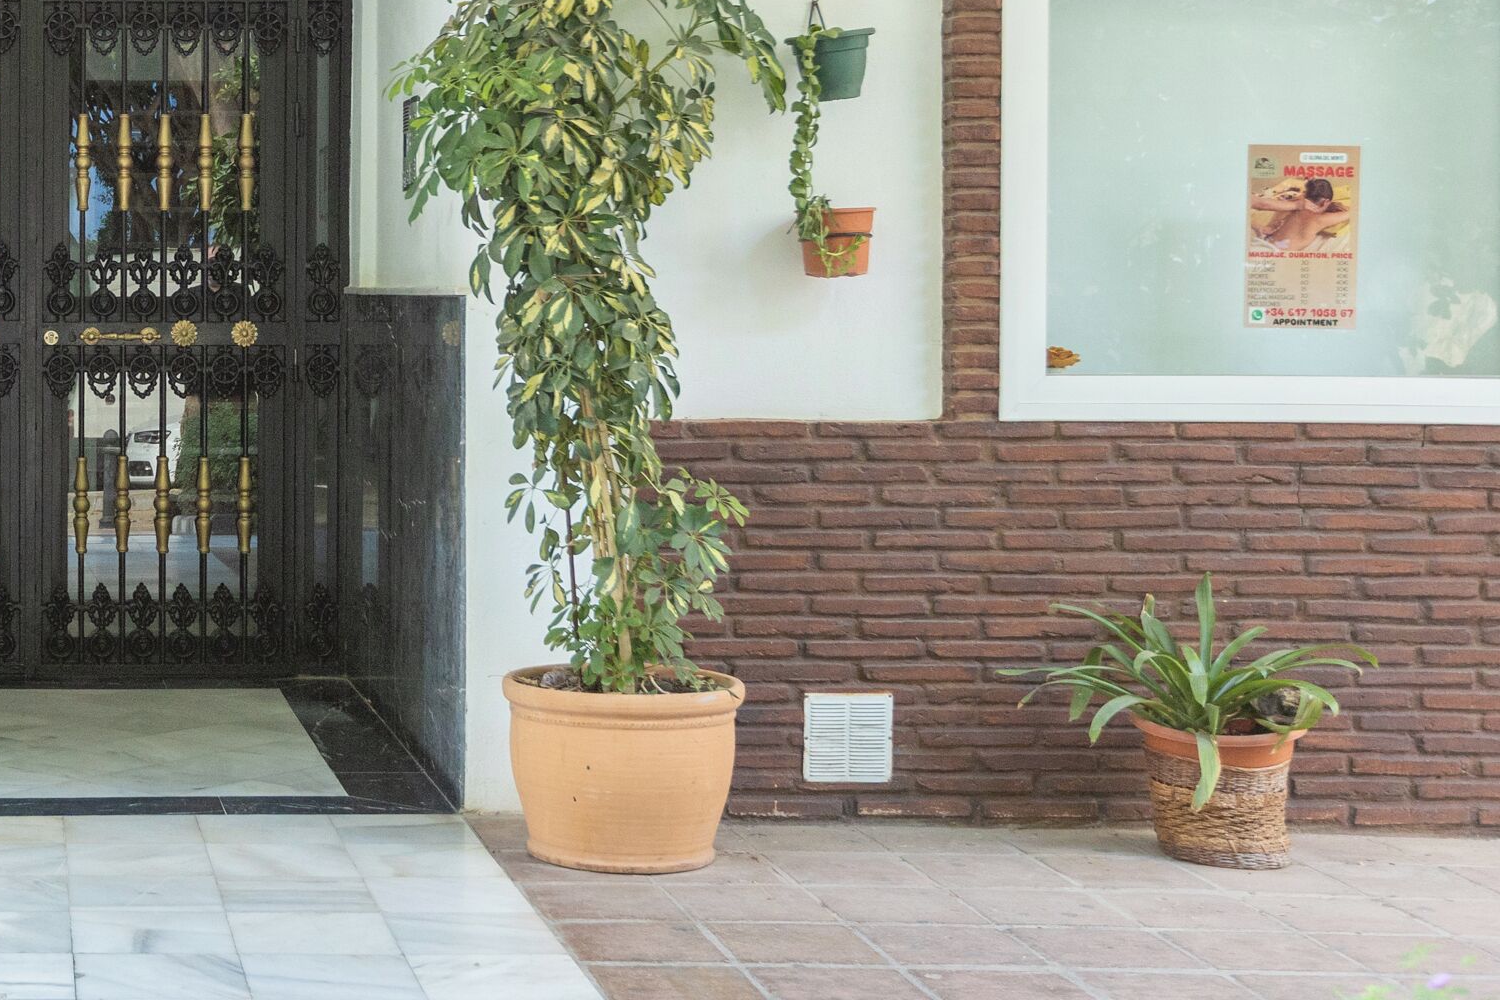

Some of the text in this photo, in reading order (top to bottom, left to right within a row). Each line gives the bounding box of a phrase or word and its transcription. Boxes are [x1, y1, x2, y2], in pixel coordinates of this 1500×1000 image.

[1283, 166, 1354, 178] MASSAGE
[1265, 307, 1284, 317] +34
[1273, 318, 1338, 327] APPOINTMENT
